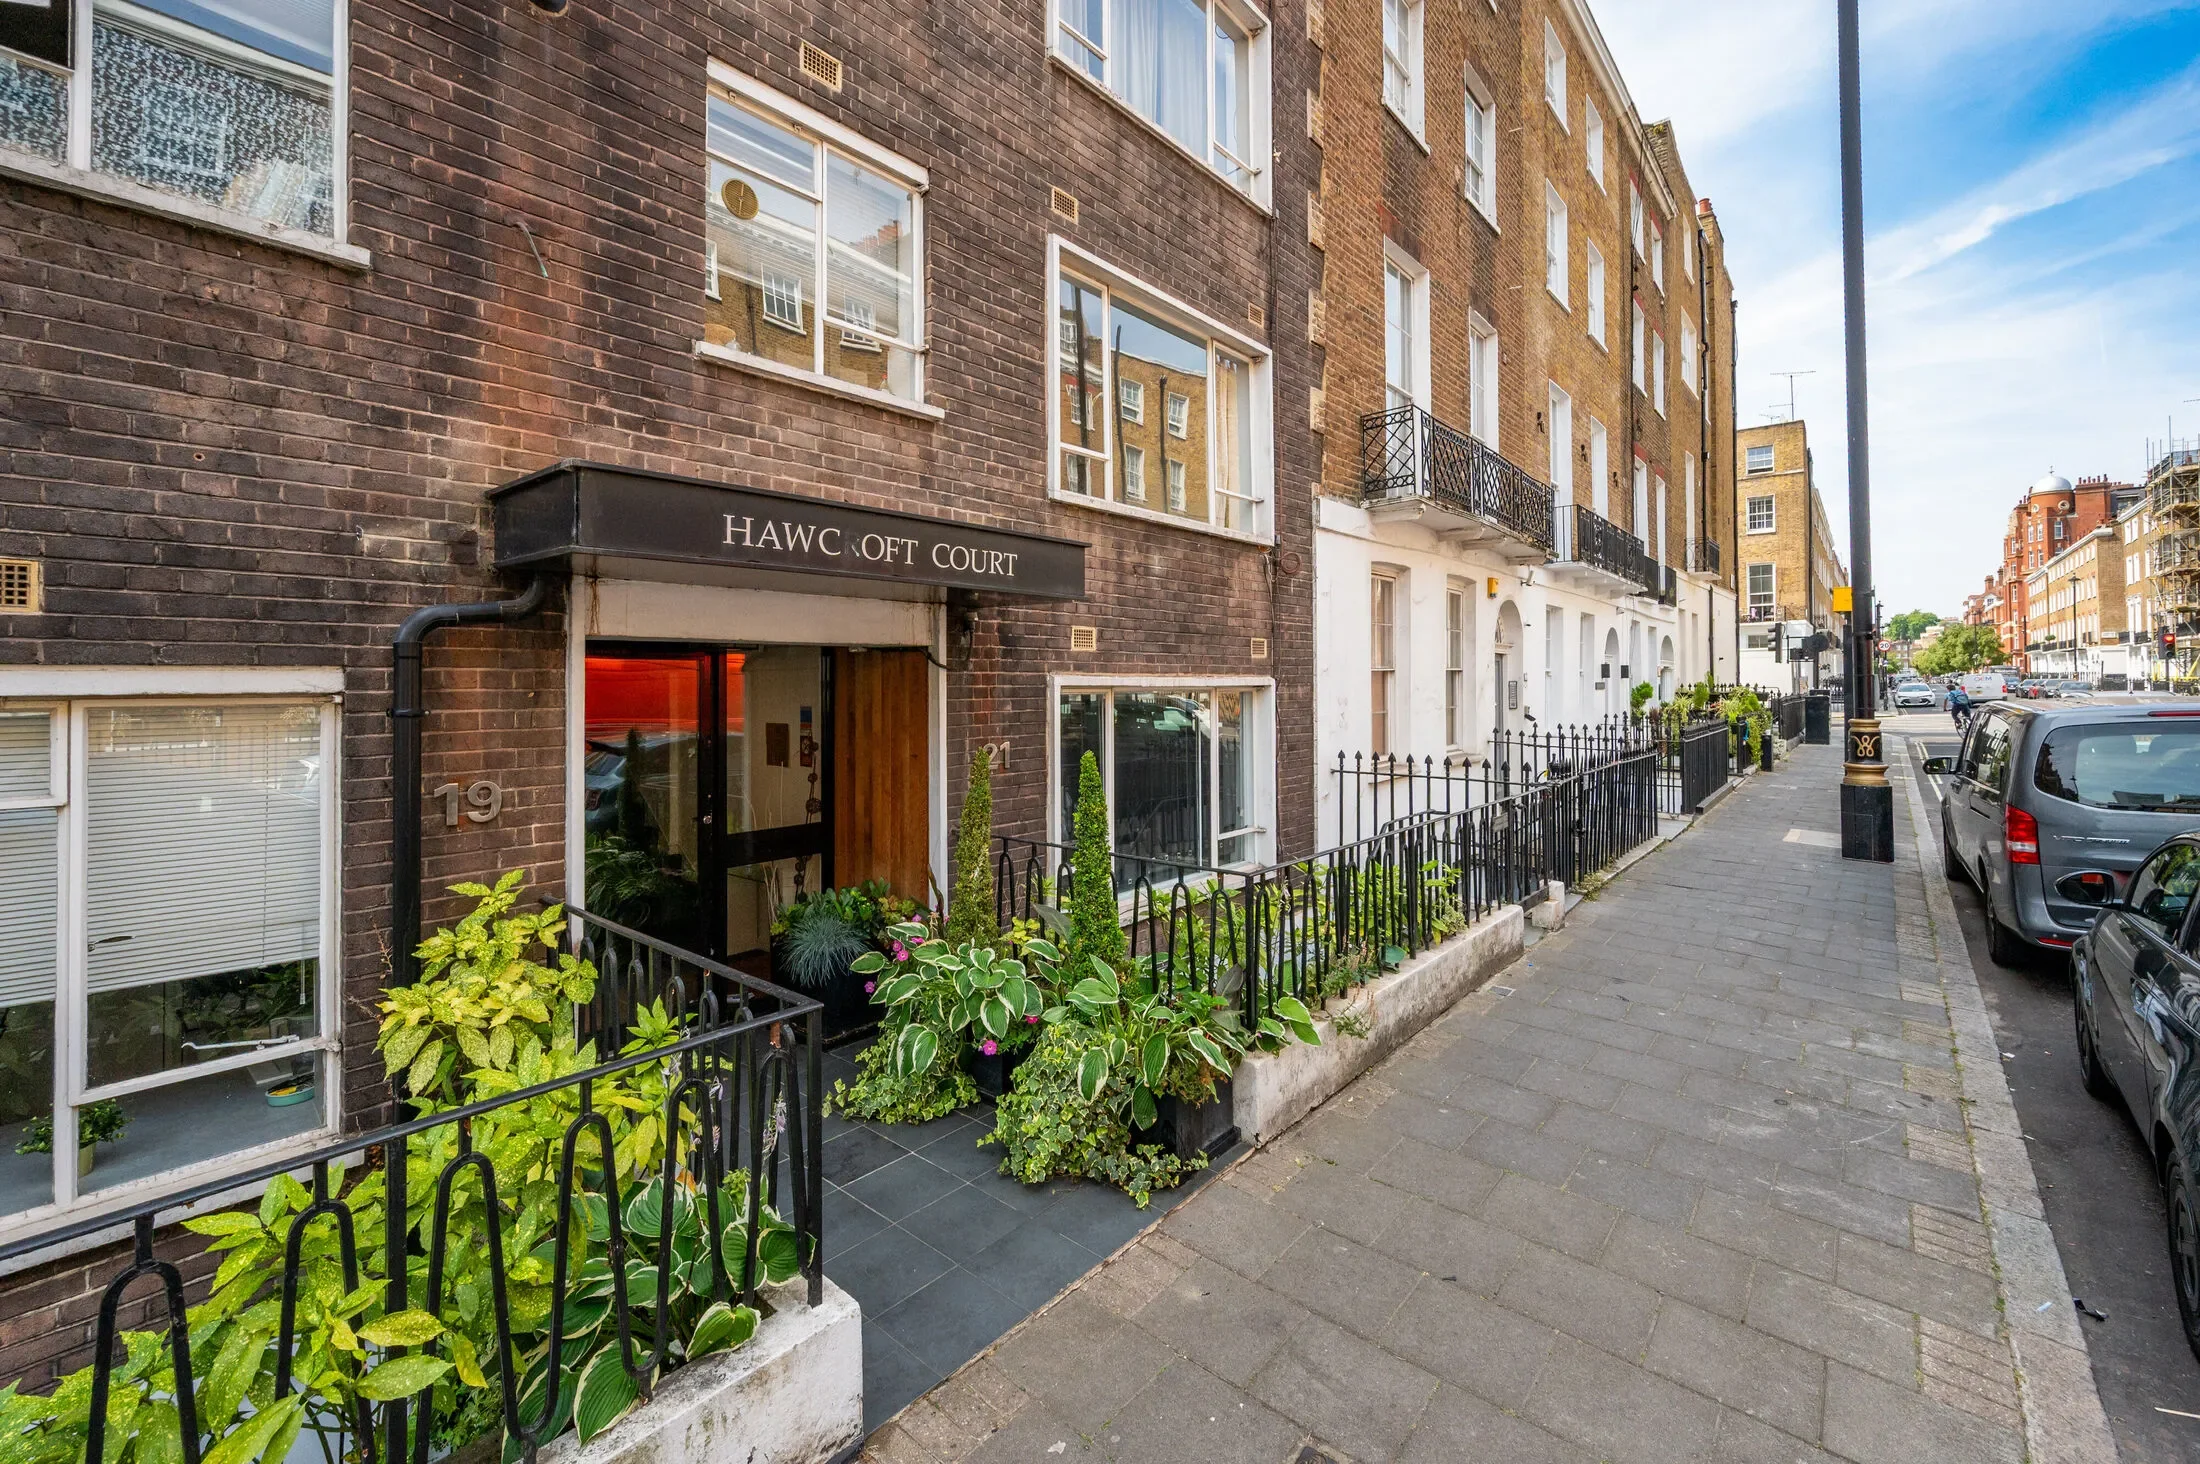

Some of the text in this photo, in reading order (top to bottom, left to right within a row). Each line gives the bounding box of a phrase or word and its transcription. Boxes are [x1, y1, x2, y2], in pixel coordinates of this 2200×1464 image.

[722, 513, 1018, 577] HAWCOFT COURT
[982, 741, 1010, 769] 21
[433, 780, 502, 826] 19
